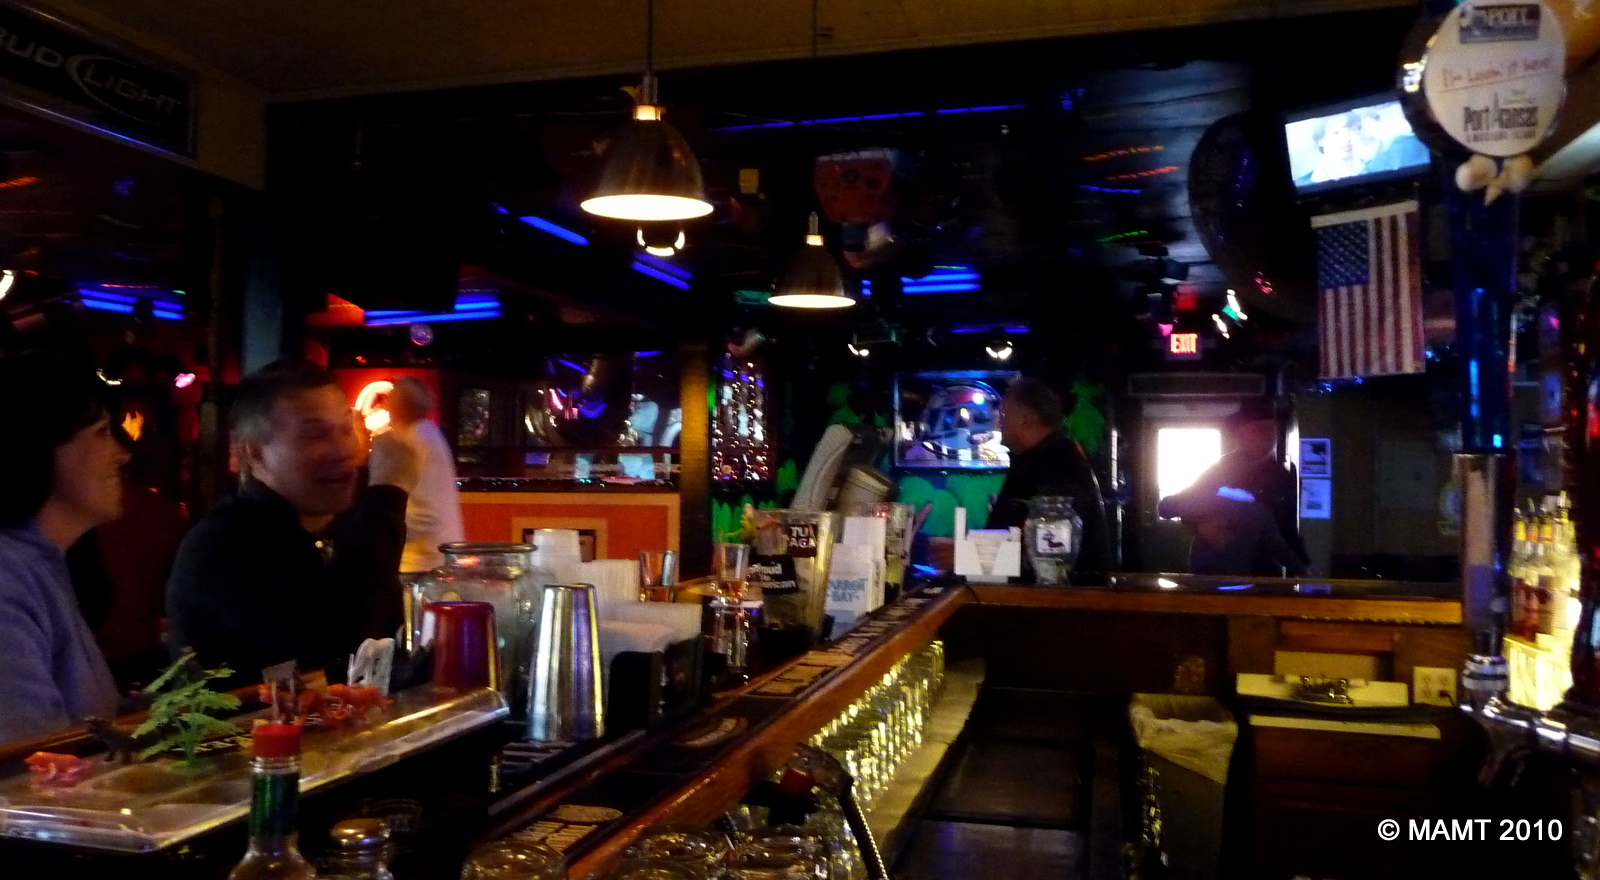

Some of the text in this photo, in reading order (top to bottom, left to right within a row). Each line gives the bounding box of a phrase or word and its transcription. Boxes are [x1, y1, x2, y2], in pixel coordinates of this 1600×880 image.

[83, 63, 184, 114] LIGHT
[1463, 106, 1490, 132] Port
[1170, 333, 1198, 353] EXIT
